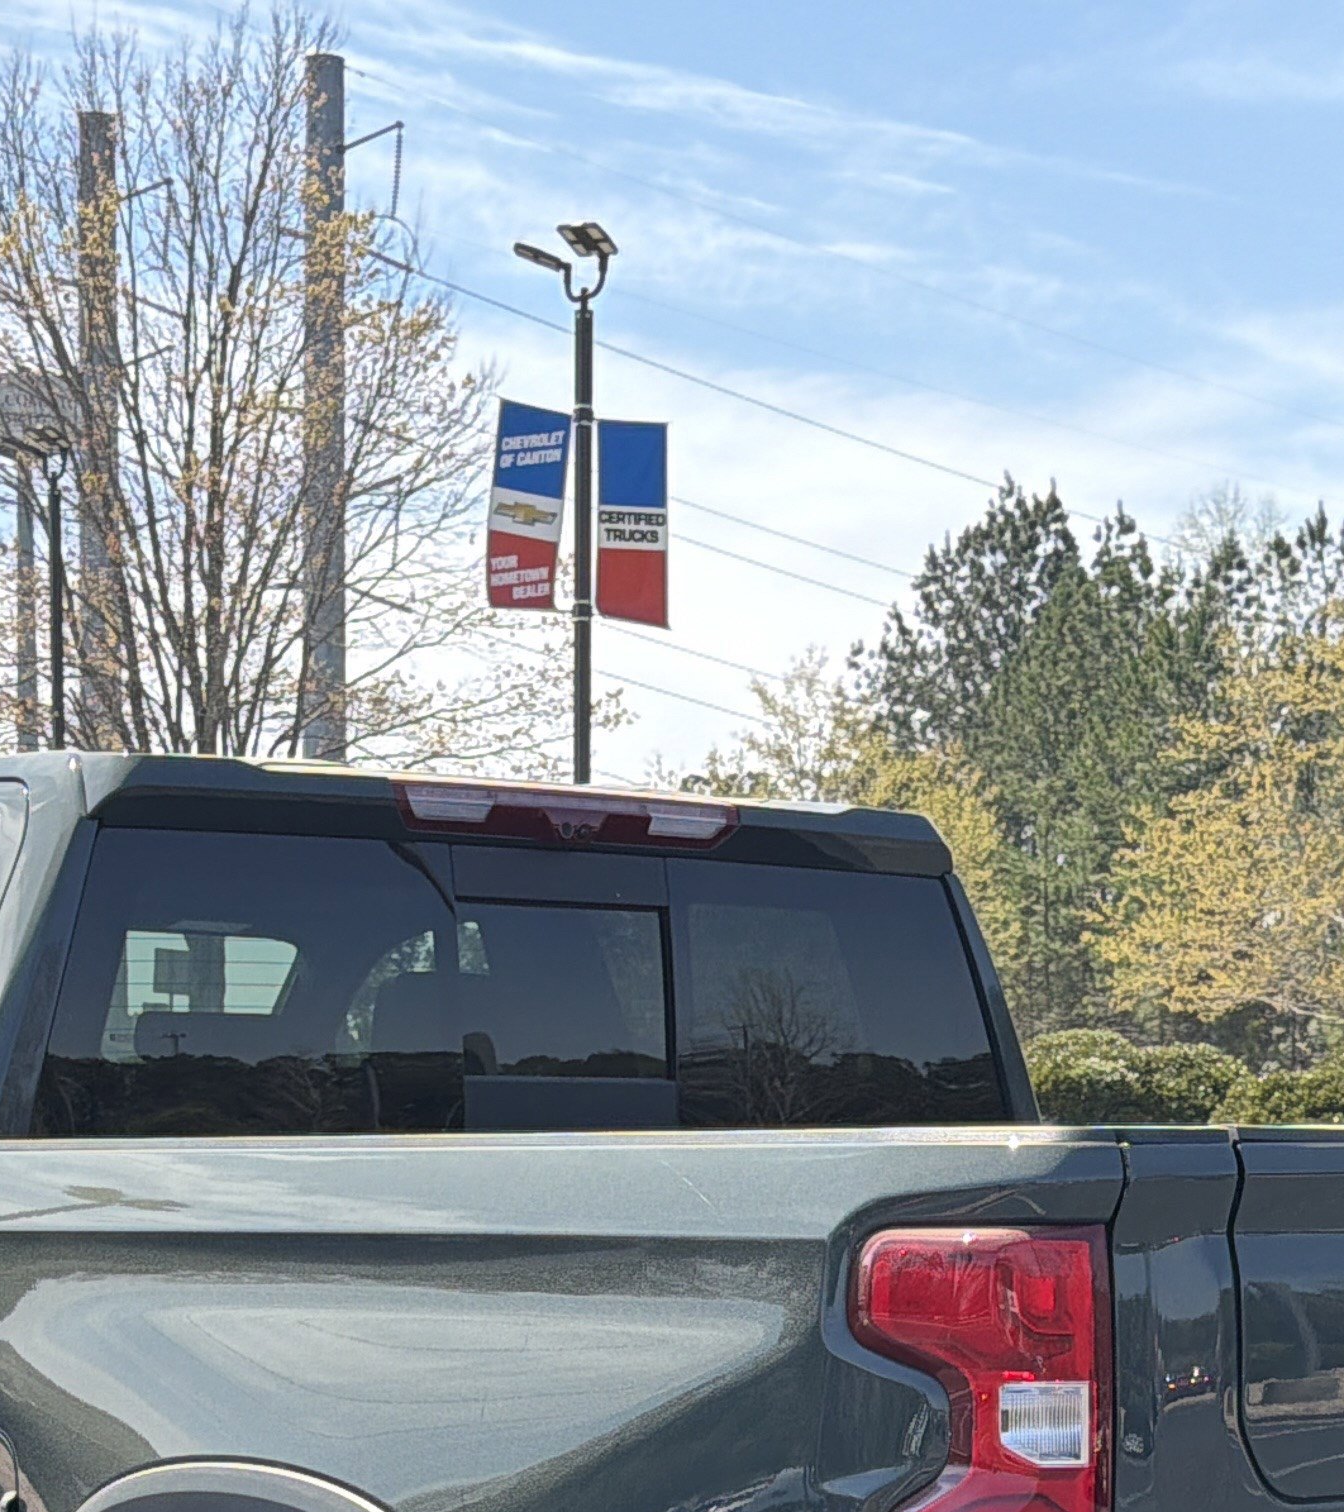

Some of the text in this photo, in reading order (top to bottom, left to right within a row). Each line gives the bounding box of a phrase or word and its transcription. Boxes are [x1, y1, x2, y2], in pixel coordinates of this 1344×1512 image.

[501, 430, 566, 451] CHEVROLET
[499, 448, 562, 468] OF CANTON
[599, 510, 666, 527] CERTIFIED
[604, 528, 659, 543] TRUCKS
